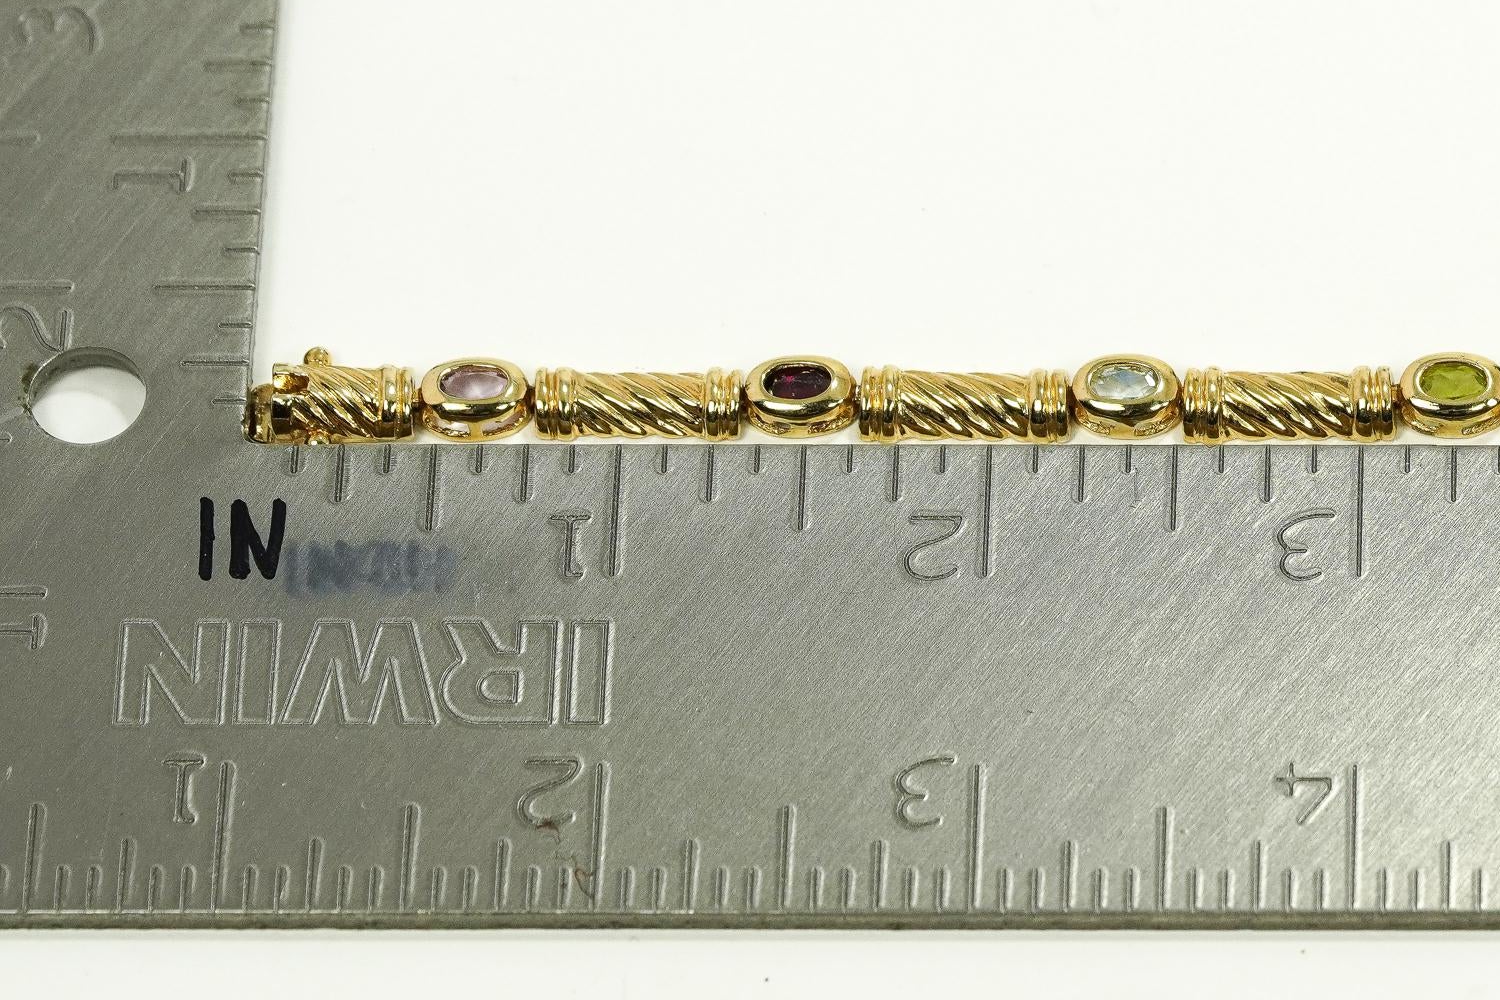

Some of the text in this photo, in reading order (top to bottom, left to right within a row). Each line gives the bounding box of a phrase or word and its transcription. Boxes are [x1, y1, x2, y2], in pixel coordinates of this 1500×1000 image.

[18, 5, 99, 55] 3
[111, 156, 195, 192] 1
[198, 496, 287, 581] IN
[551, 510, 591, 577] 1
[903, 514, 963, 582] 2
[1276, 509, 1335, 581] 3
[111, 618, 615, 726] IRWIN
[164, 756, 205, 823] 1
[517, 757, 582, 827] 2
[895, 756, 957, 829] 3
[1275, 762, 1333, 826] 4
